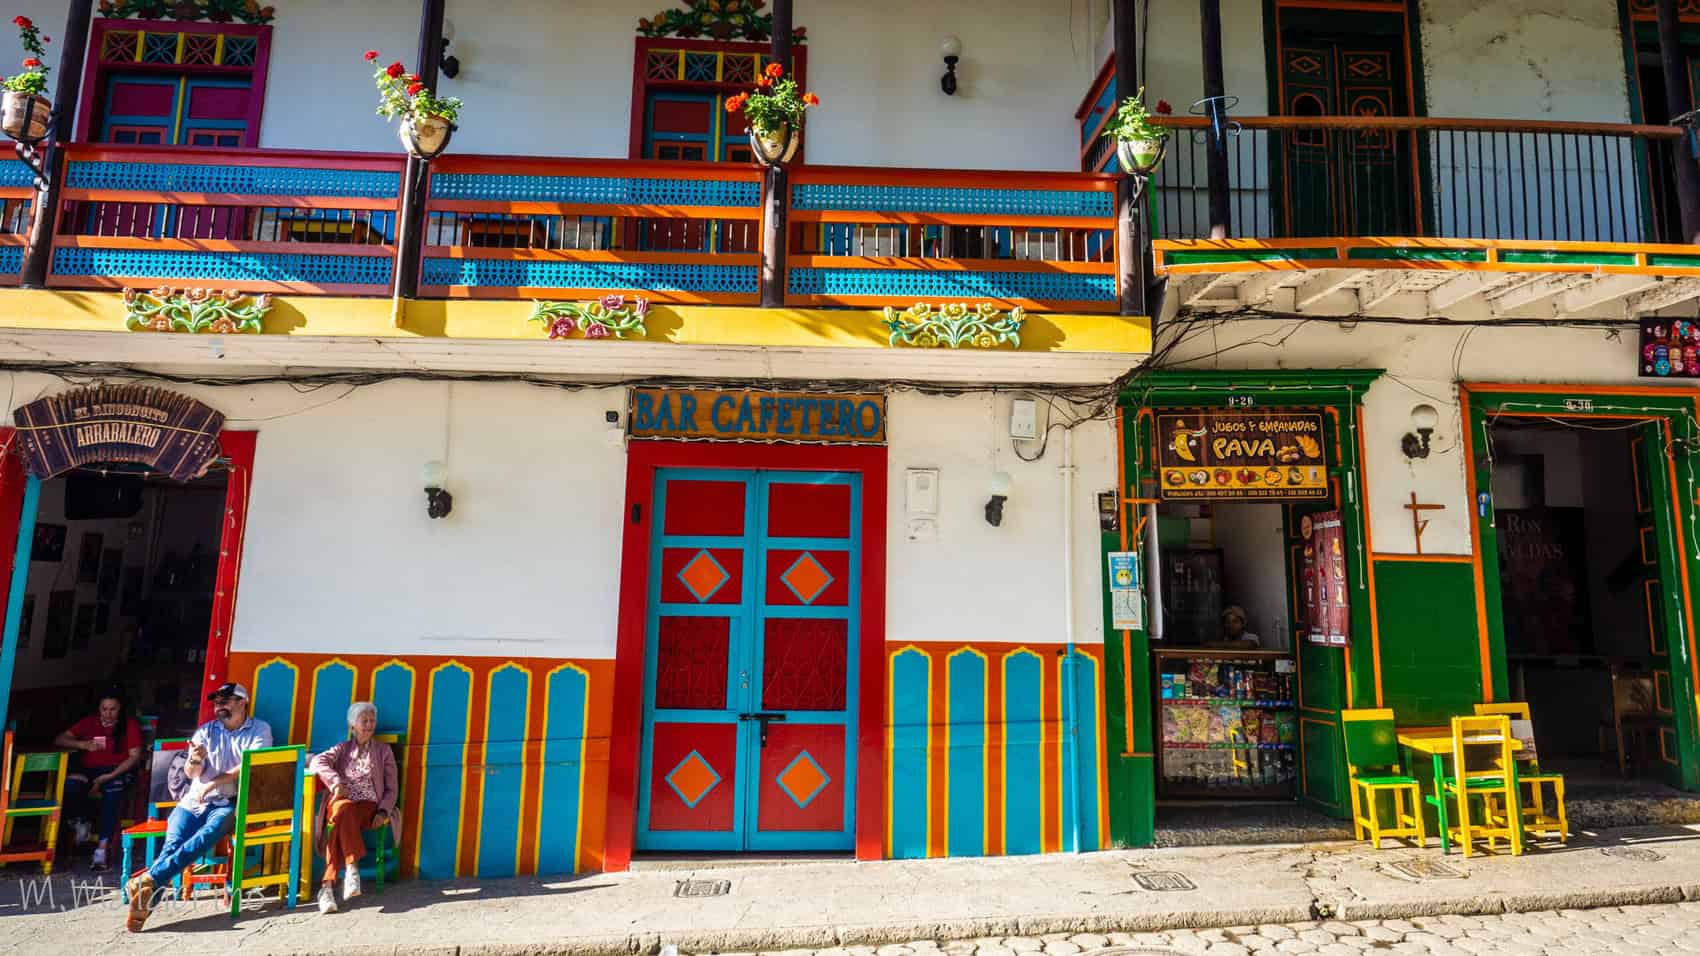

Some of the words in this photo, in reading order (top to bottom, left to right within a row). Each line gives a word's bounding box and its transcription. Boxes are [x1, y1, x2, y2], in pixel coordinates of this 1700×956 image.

[73, 407, 90, 420] EL
[634, 392, 698, 431] BAR
[712, 396, 881, 438] CAFETERO
[77, 423, 161, 449] ARRABALERO
[1212, 421, 1247, 433] JUGOS
[1259, 420, 1318, 433] EMPANADAS
[1212, 437, 1276, 459] PAVA
